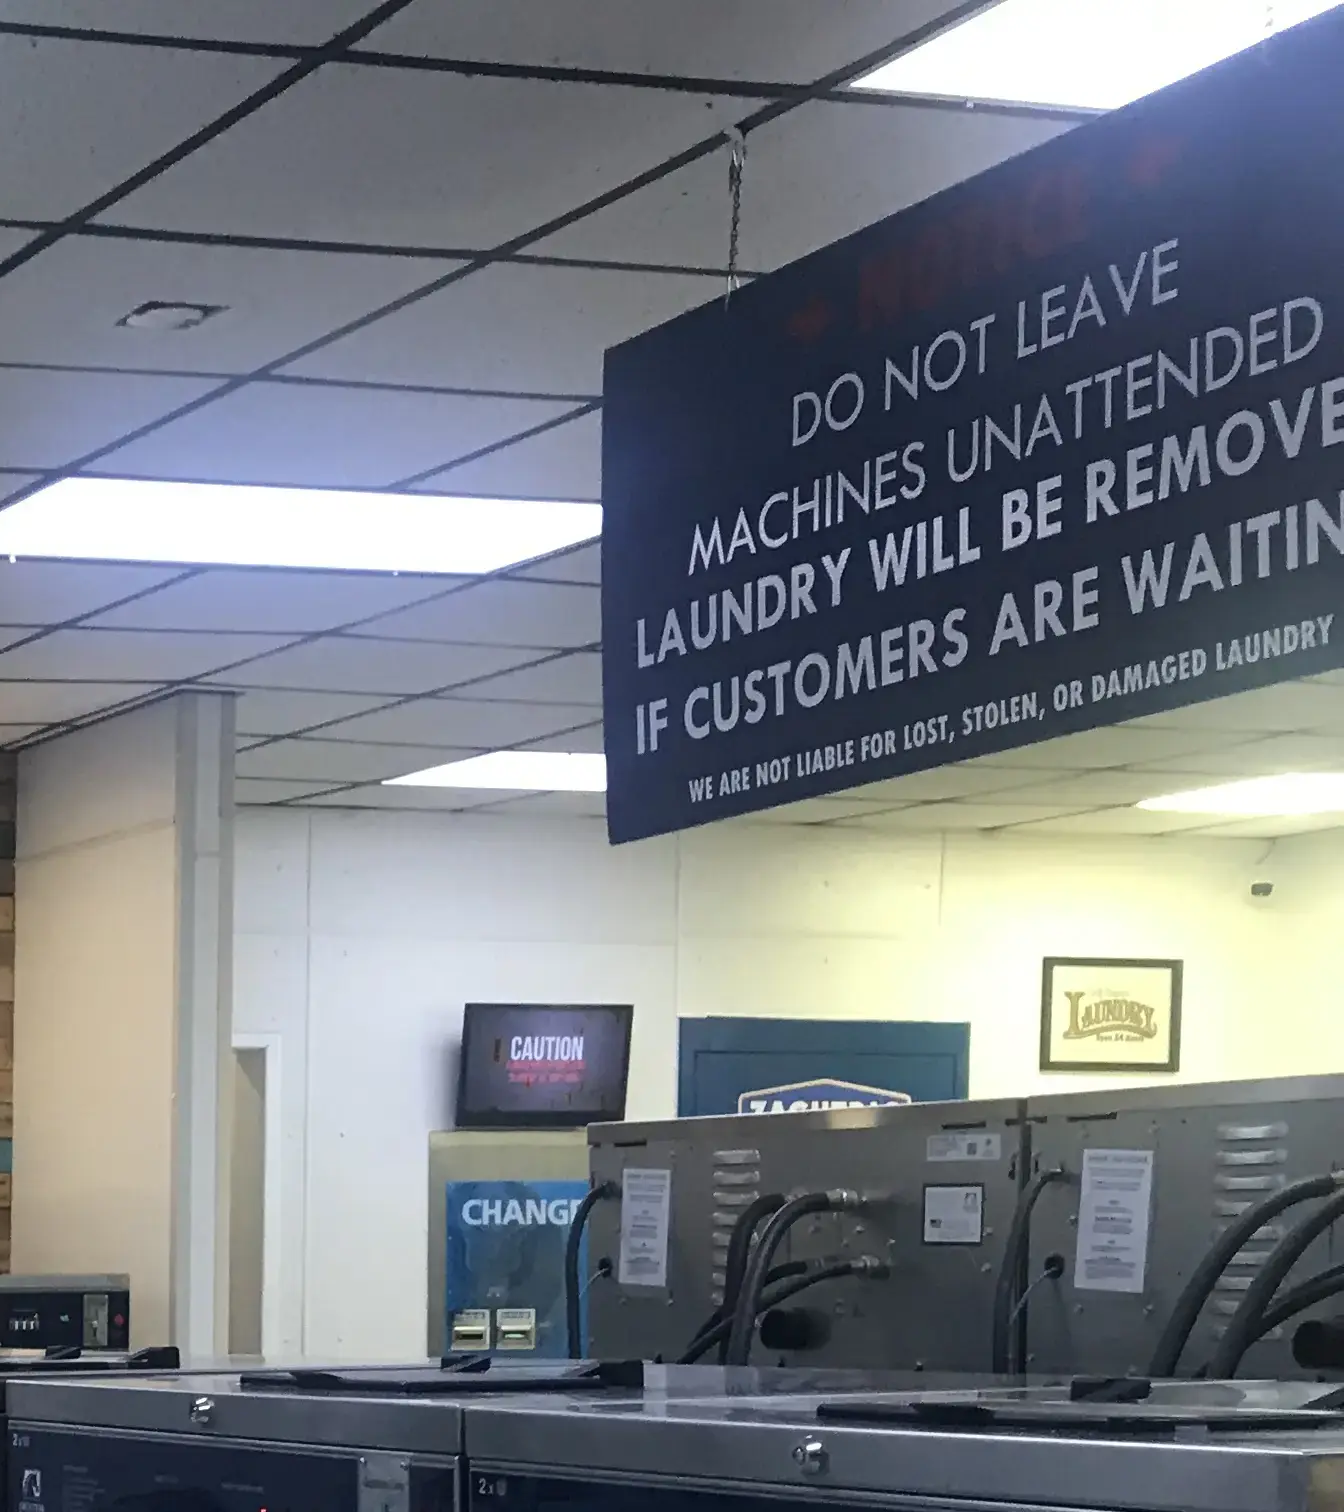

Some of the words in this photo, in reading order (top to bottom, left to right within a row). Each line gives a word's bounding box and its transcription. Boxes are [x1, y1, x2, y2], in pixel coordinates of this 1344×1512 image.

[689, 442, 926, 576] MACHINES
[948, 296, 1324, 483] UNATTENDED
[793, 373, 865, 447] DO
[885, 314, 996, 410] NOT
[1018, 238, 1179, 358] LEAVE
[636, 698, 669, 755] IF
[684, 608, 969, 739] CUSTOMERS
[989, 566, 1100, 656] ARE
[637, 548, 852, 669] LAUNDRY
[868, 507, 981, 592] WILL
[1002, 474, 1063, 552] BE
[689, 776, 714, 803] WE
[719, 767, 751, 797] ARE
[756, 756, 791, 788] NOT
[796, 740, 855, 778] LIABLE
[860, 730, 897, 763] FOR
[903, 715, 955, 751] LOST,
[962, 692, 1046, 736] STOLEN,
[1053, 680, 1084, 712] OR
[1091, 649, 1207, 703] DAMAGED
[1215, 615, 1335, 671] LAUNDRY
[510, 1035, 584, 1061] CAUTION
